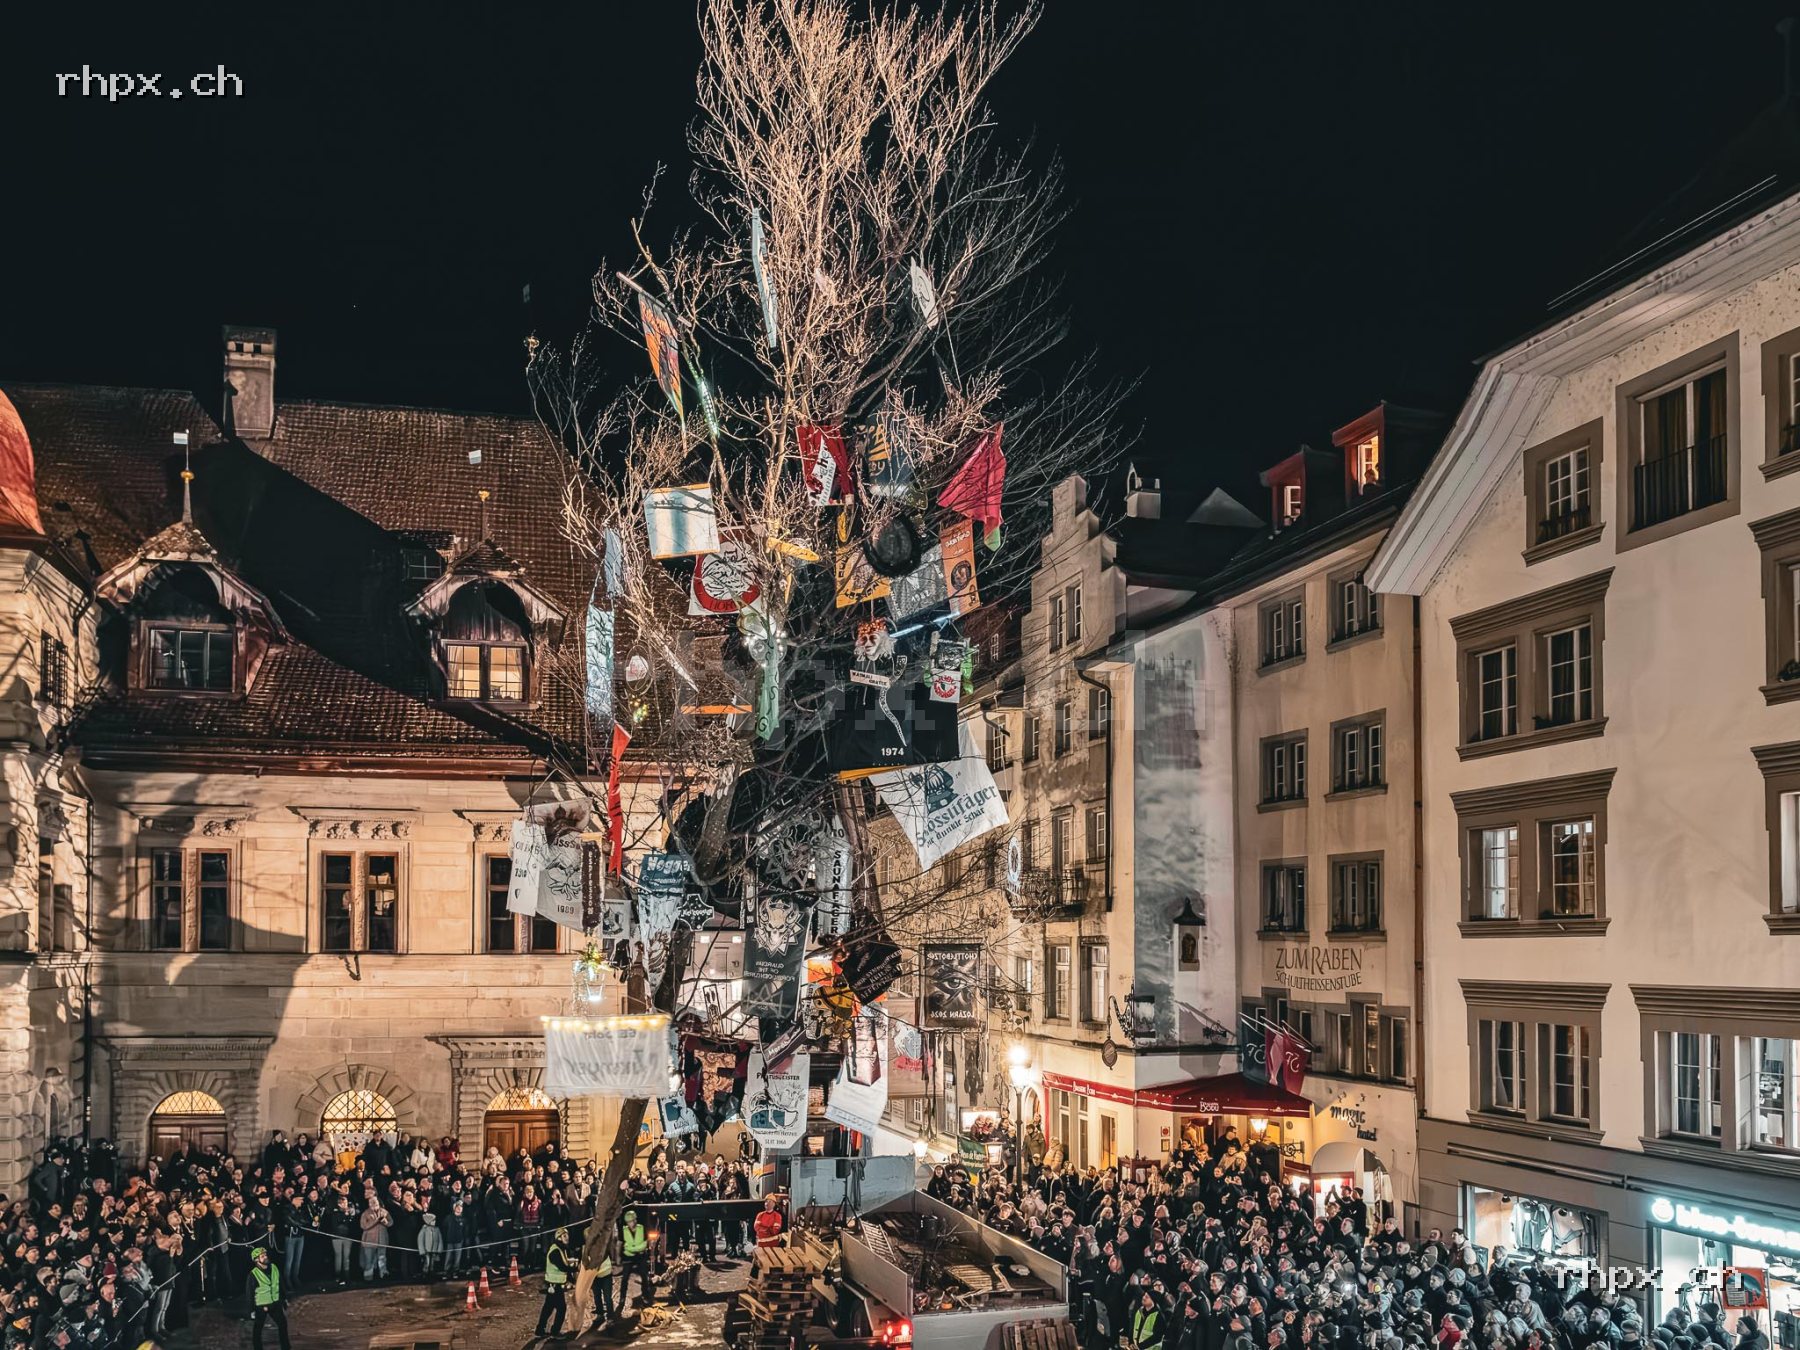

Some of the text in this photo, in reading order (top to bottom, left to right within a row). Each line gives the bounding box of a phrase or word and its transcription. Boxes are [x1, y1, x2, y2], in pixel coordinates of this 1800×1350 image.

[881, 747, 905, 756] 1974
[1275, 946, 1362, 975] ZUM RABEN
[1275, 970, 1362, 991] SCHULTHEISSENSTUBE
[1330, 1103, 1366, 1129] magic
[1356, 1124, 1378, 1142] hotel
